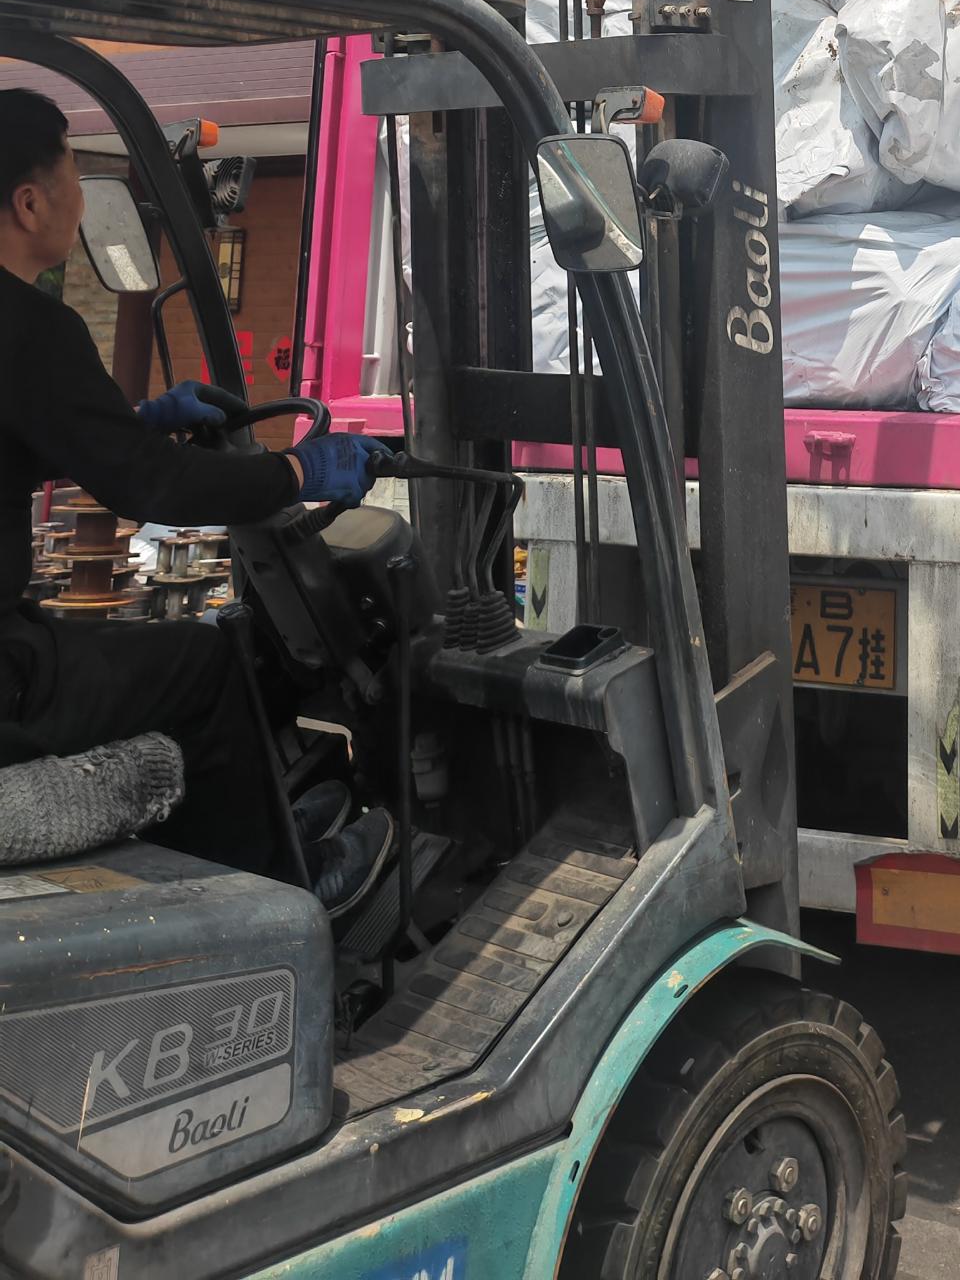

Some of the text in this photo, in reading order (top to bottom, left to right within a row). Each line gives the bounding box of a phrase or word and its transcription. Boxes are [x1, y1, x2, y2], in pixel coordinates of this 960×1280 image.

[727, 180, 774, 354] Baoli
[794, 623, 886, 681] A7挂
[85, 990, 285, 1113] KB 30
[204, 1031, 276, 1067] W-SERIES
[168, 1096, 250, 1154] Baoli
